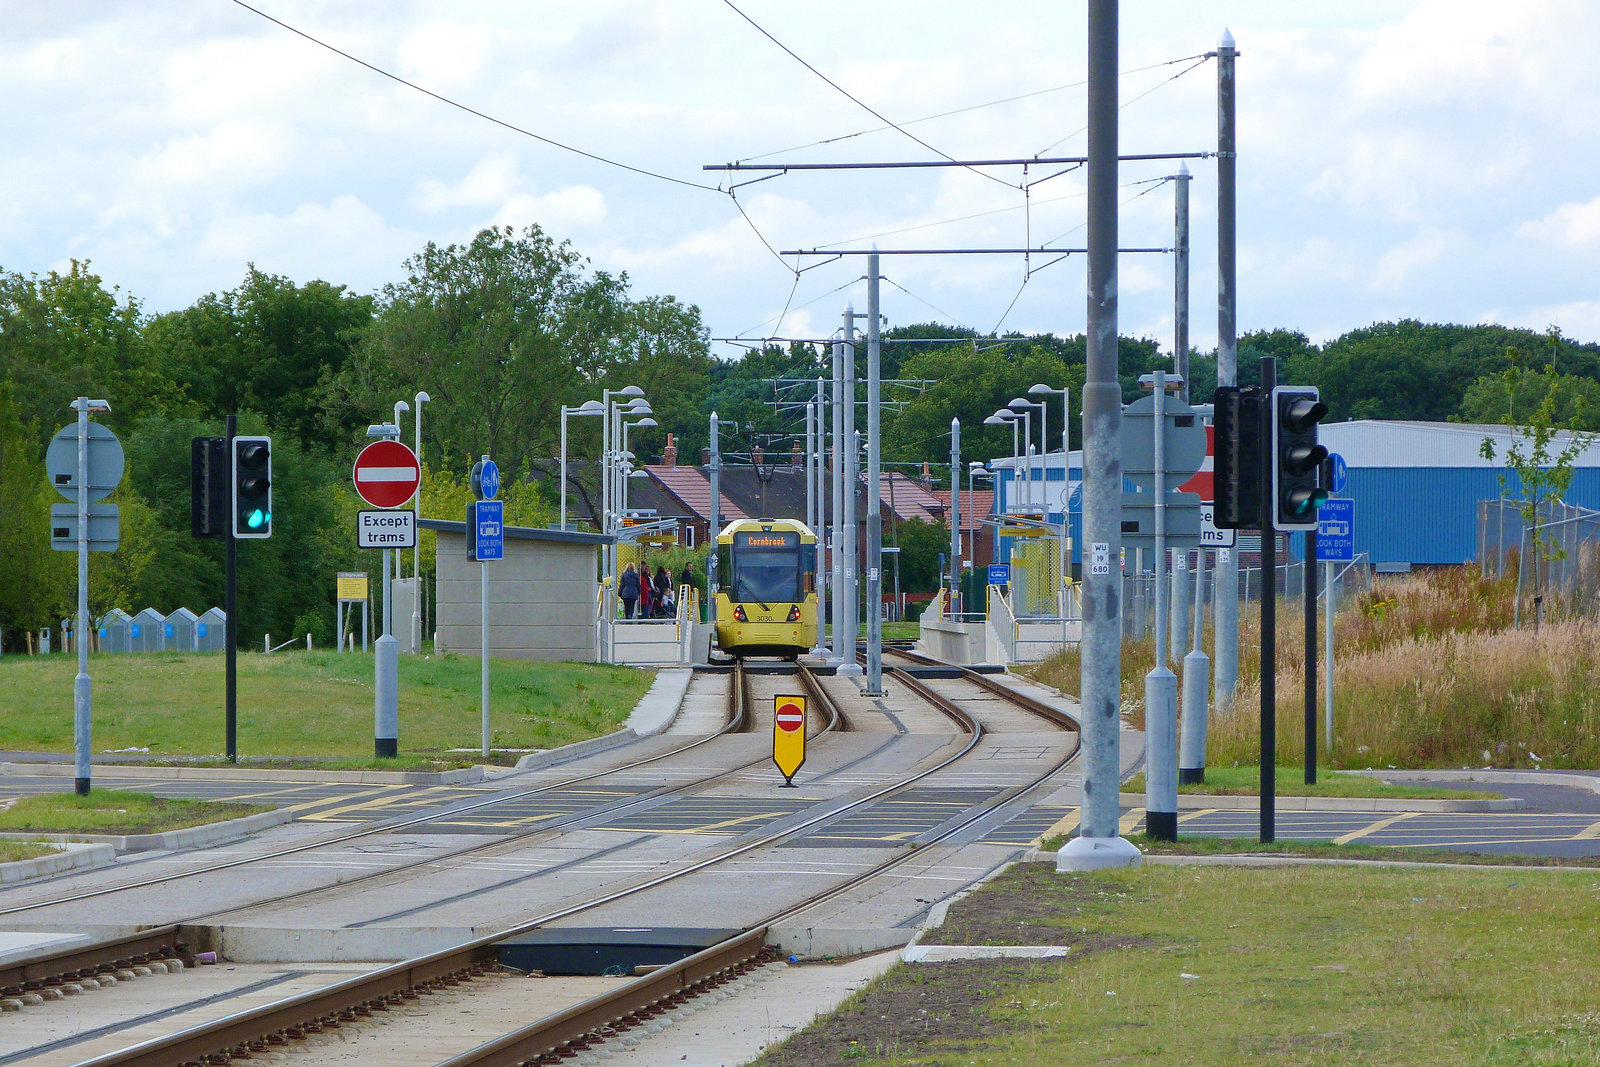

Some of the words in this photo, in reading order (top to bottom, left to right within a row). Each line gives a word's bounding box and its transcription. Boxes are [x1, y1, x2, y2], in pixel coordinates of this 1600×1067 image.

[363, 515, 409, 528] Except
[367, 531, 405, 543] trams
[1334, 539, 1352, 548] BOTH
[1325, 548, 1343, 557] WAYS
[1093, 565, 1108, 573] 680
